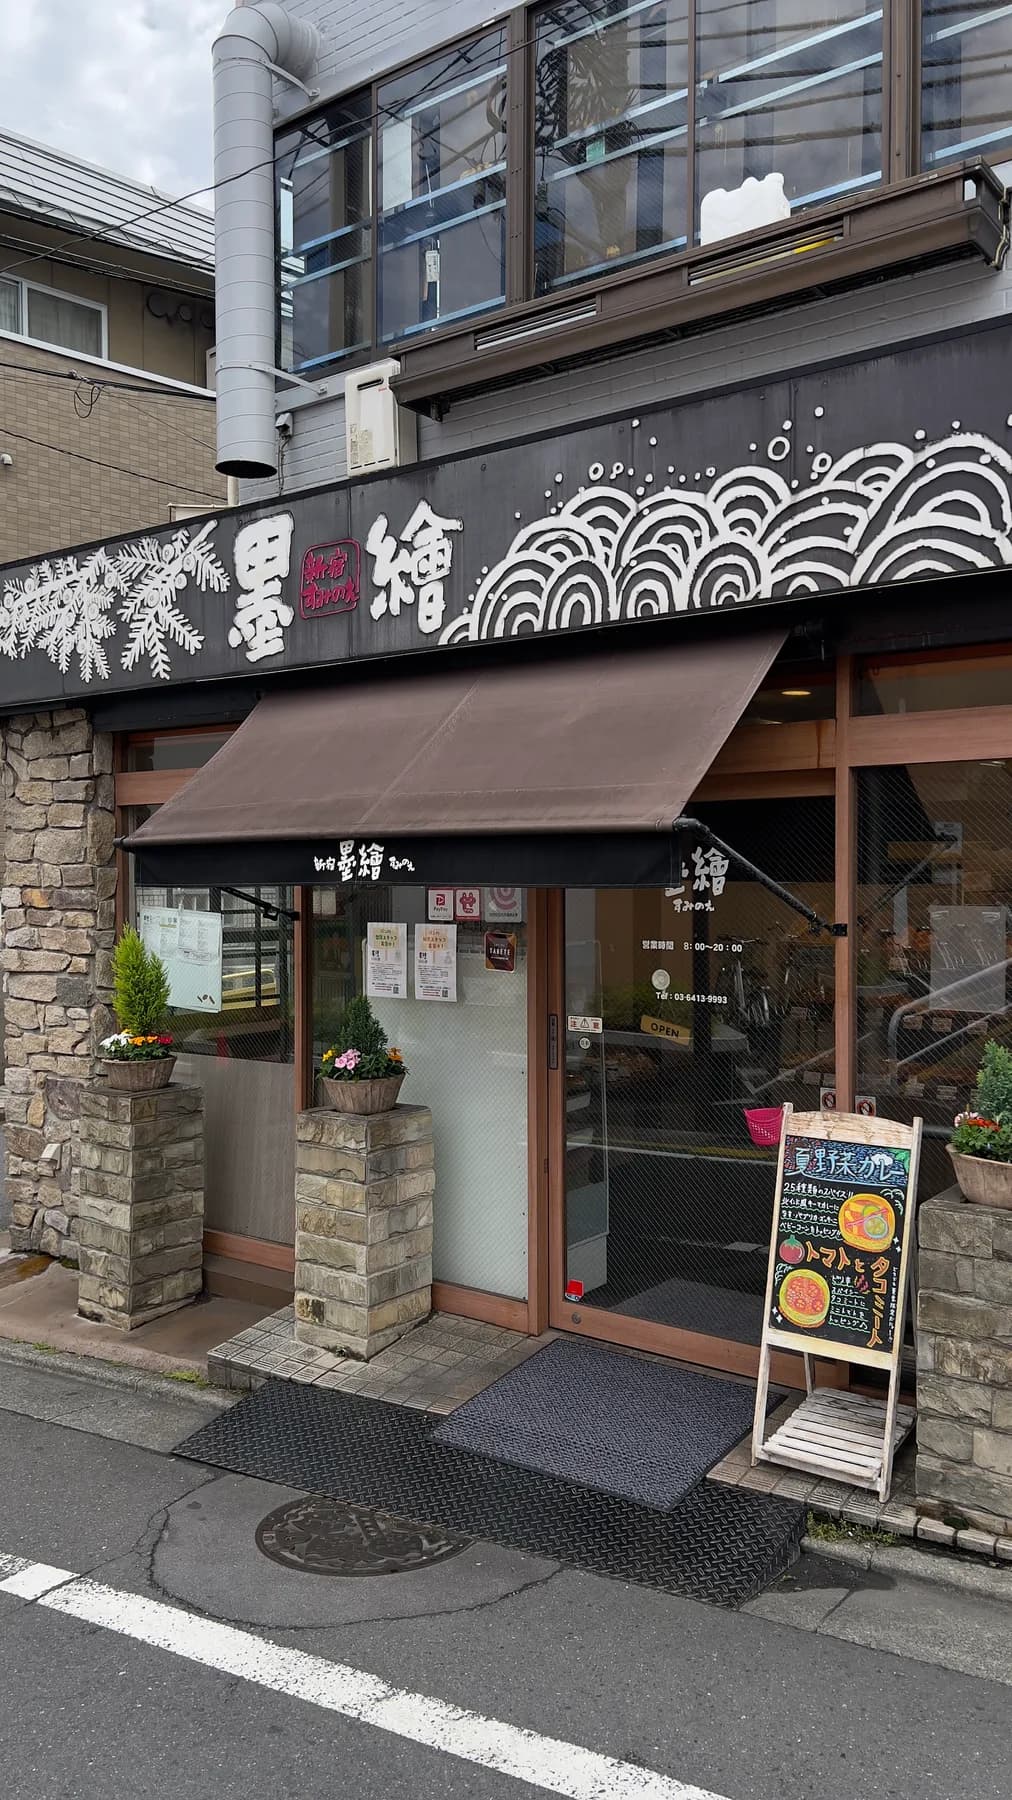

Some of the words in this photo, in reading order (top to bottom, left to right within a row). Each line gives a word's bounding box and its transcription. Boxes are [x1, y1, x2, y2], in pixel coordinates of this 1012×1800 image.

[304, 547, 348, 584] 新宿
[672, 898, 715, 914] すみのえ
[650, 1022, 680, 1038] OPEN
[785, 1147, 905, 1183] 夏野菜カレー
